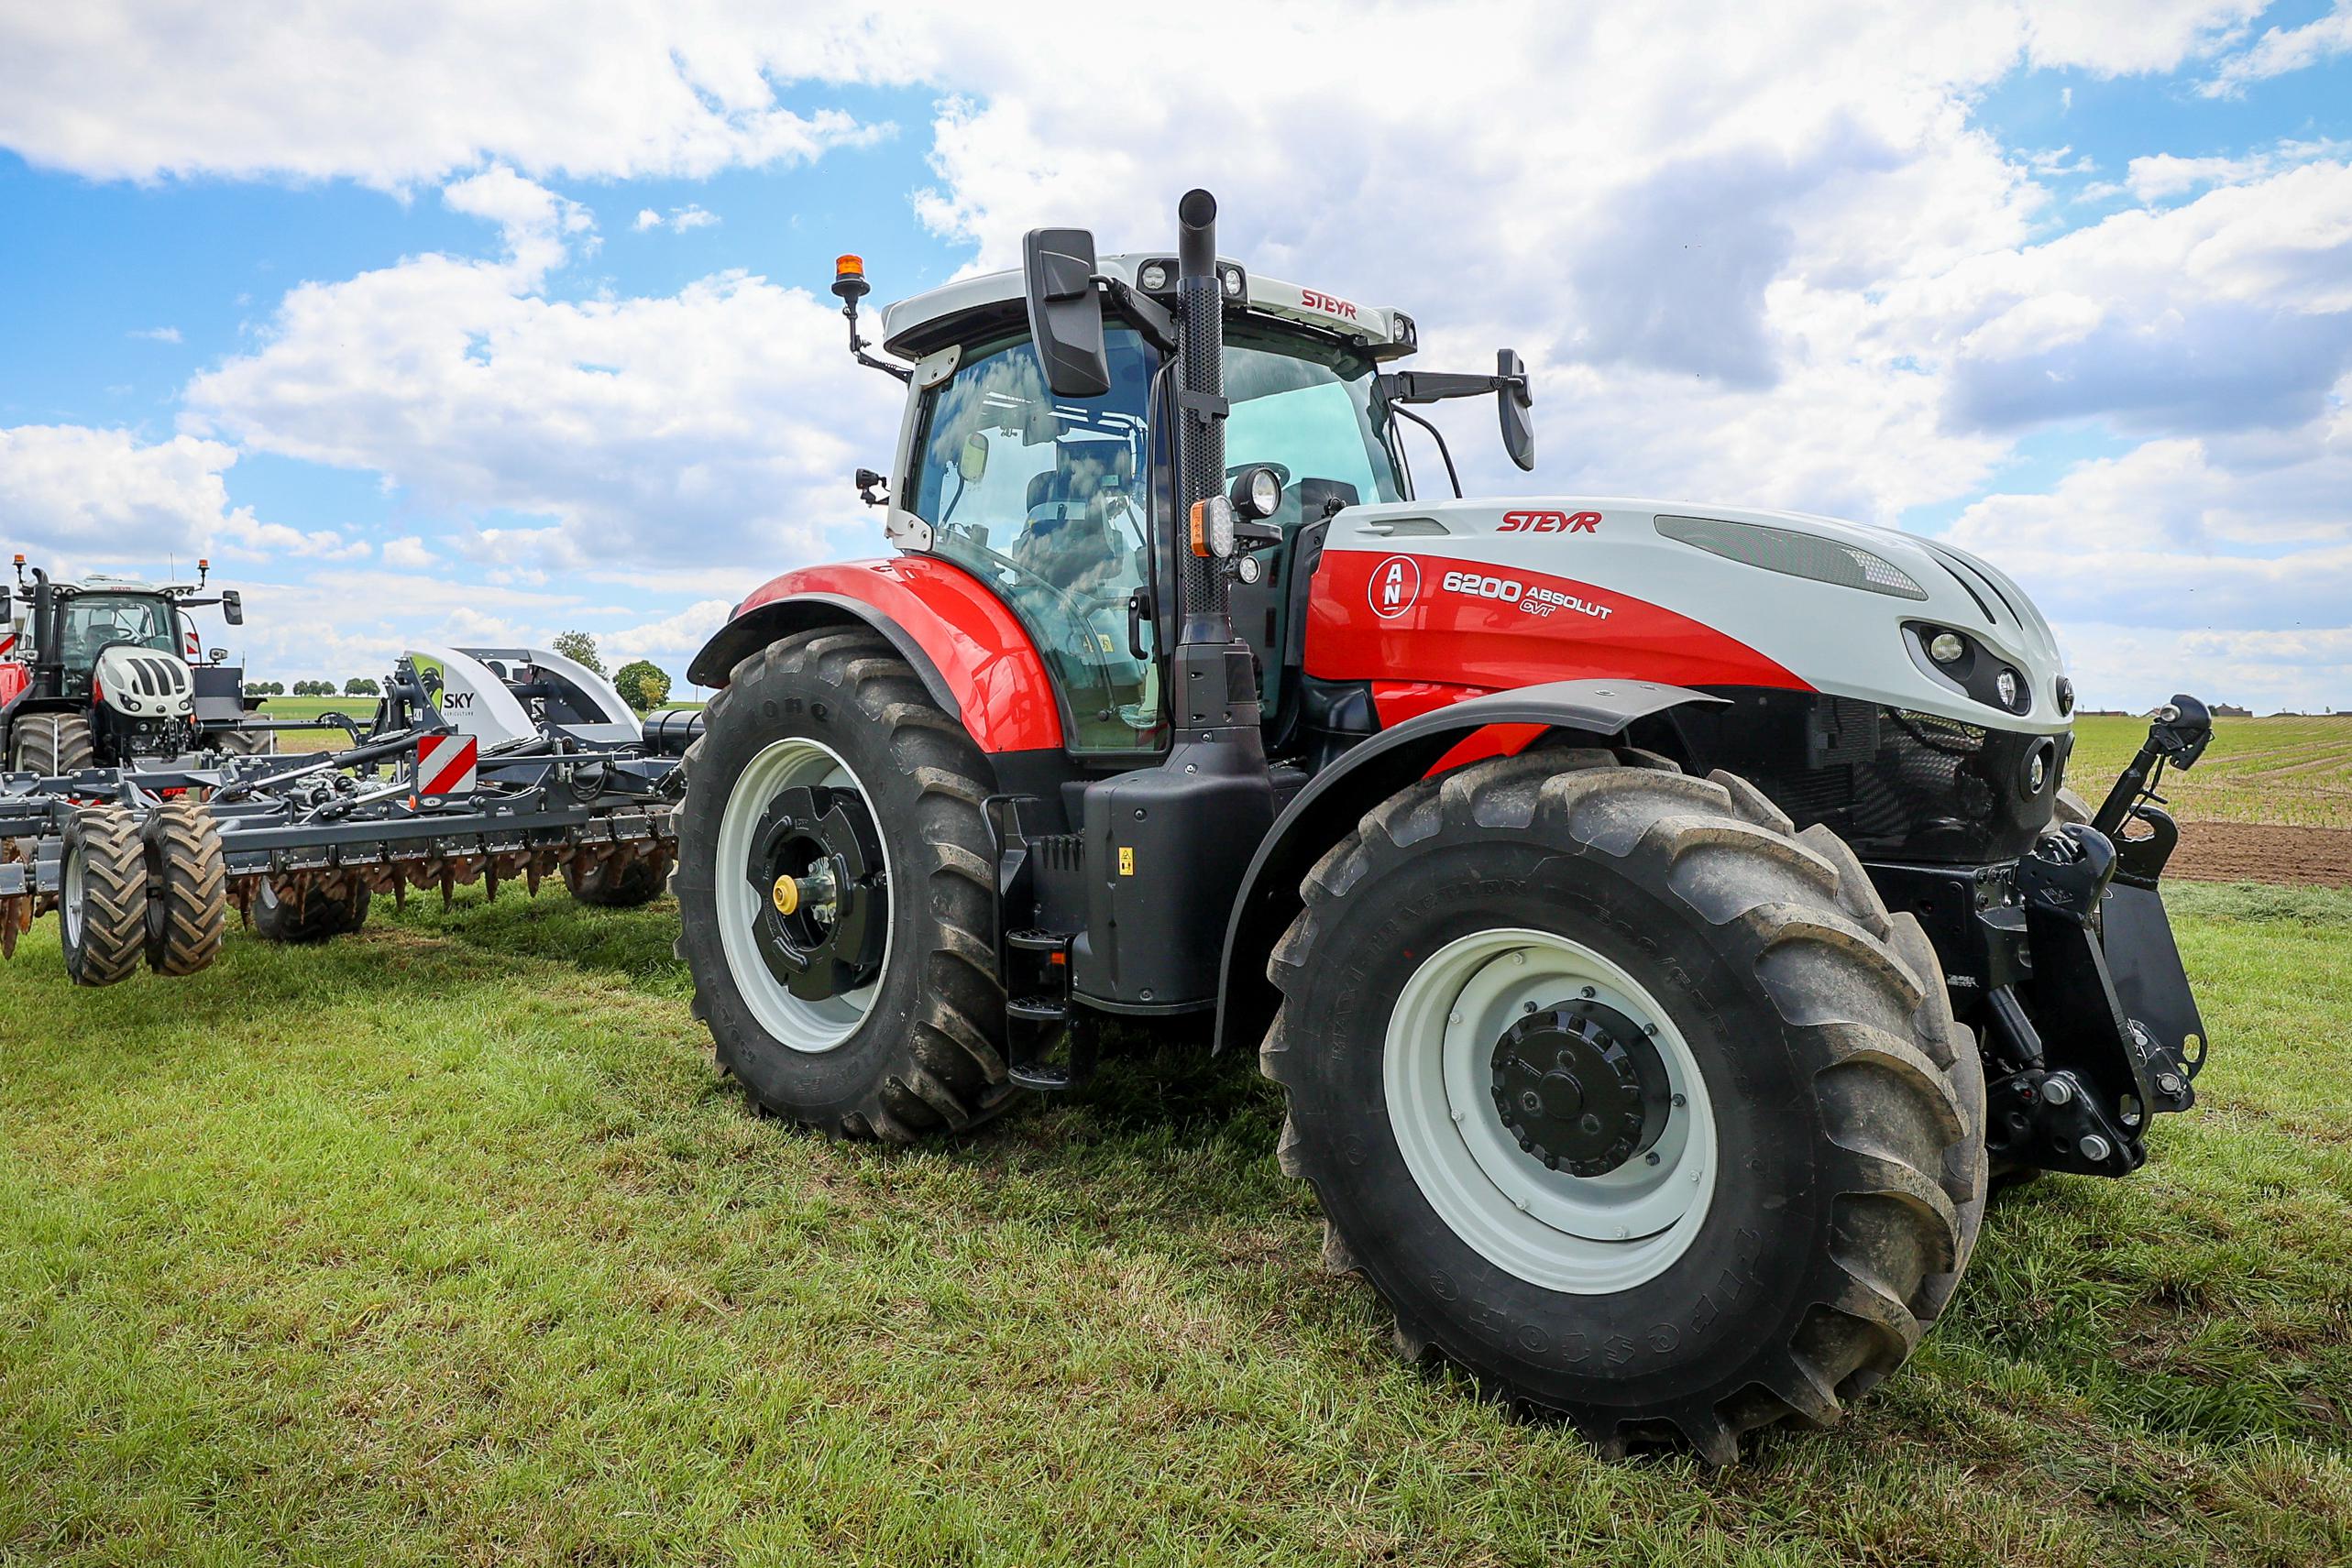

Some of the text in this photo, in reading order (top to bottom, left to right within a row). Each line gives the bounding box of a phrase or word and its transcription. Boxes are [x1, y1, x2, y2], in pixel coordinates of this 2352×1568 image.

[1301, 289, 1357, 321] STEYR
[1495, 510, 1603, 533] STEYR
[1443, 571, 1613, 620] 6200 ABSOLUT
[1519, 598, 1556, 618] CVT
[444, 692, 475, 709] SKY
